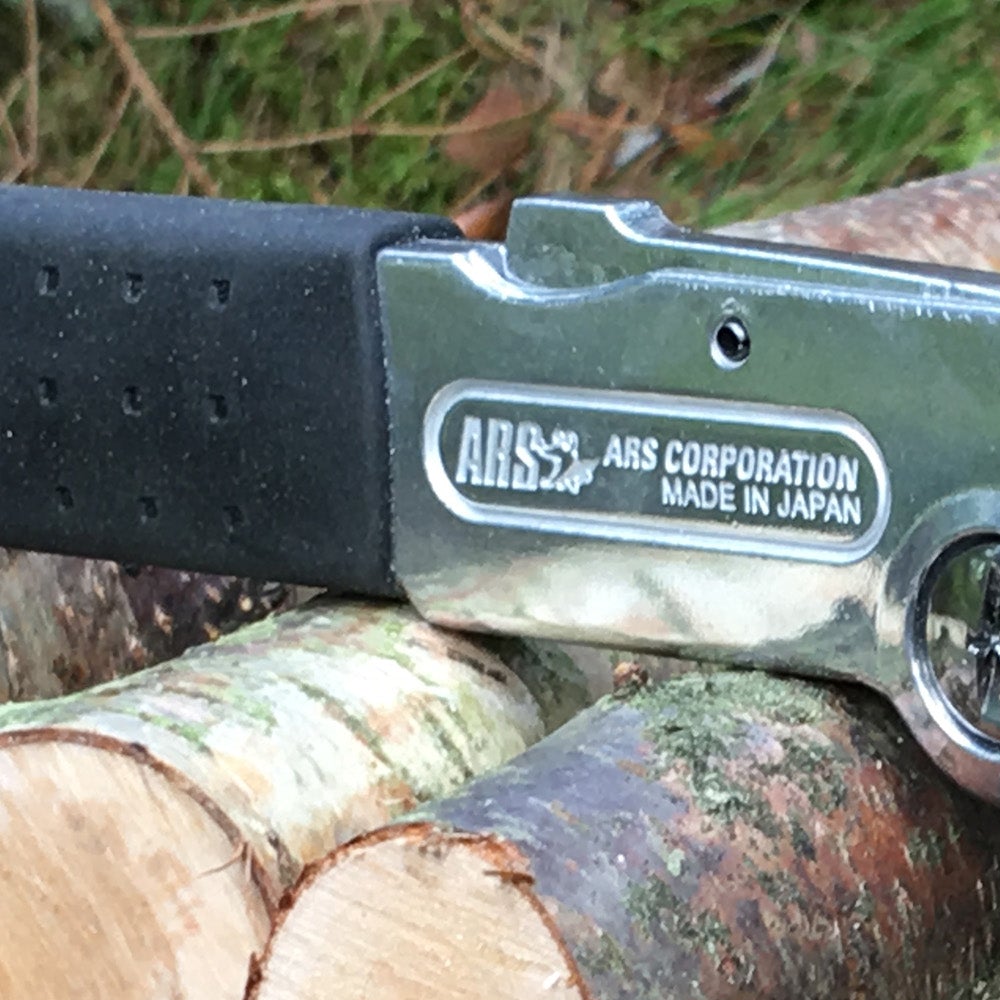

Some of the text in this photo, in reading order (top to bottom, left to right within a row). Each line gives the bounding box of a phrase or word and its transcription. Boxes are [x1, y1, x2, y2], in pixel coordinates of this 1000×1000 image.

[455, 415, 541, 492] ARS
[603, 434, 858, 492] ARS CORPORATION
[660, 477, 862, 525] MADE IN JAPAN
